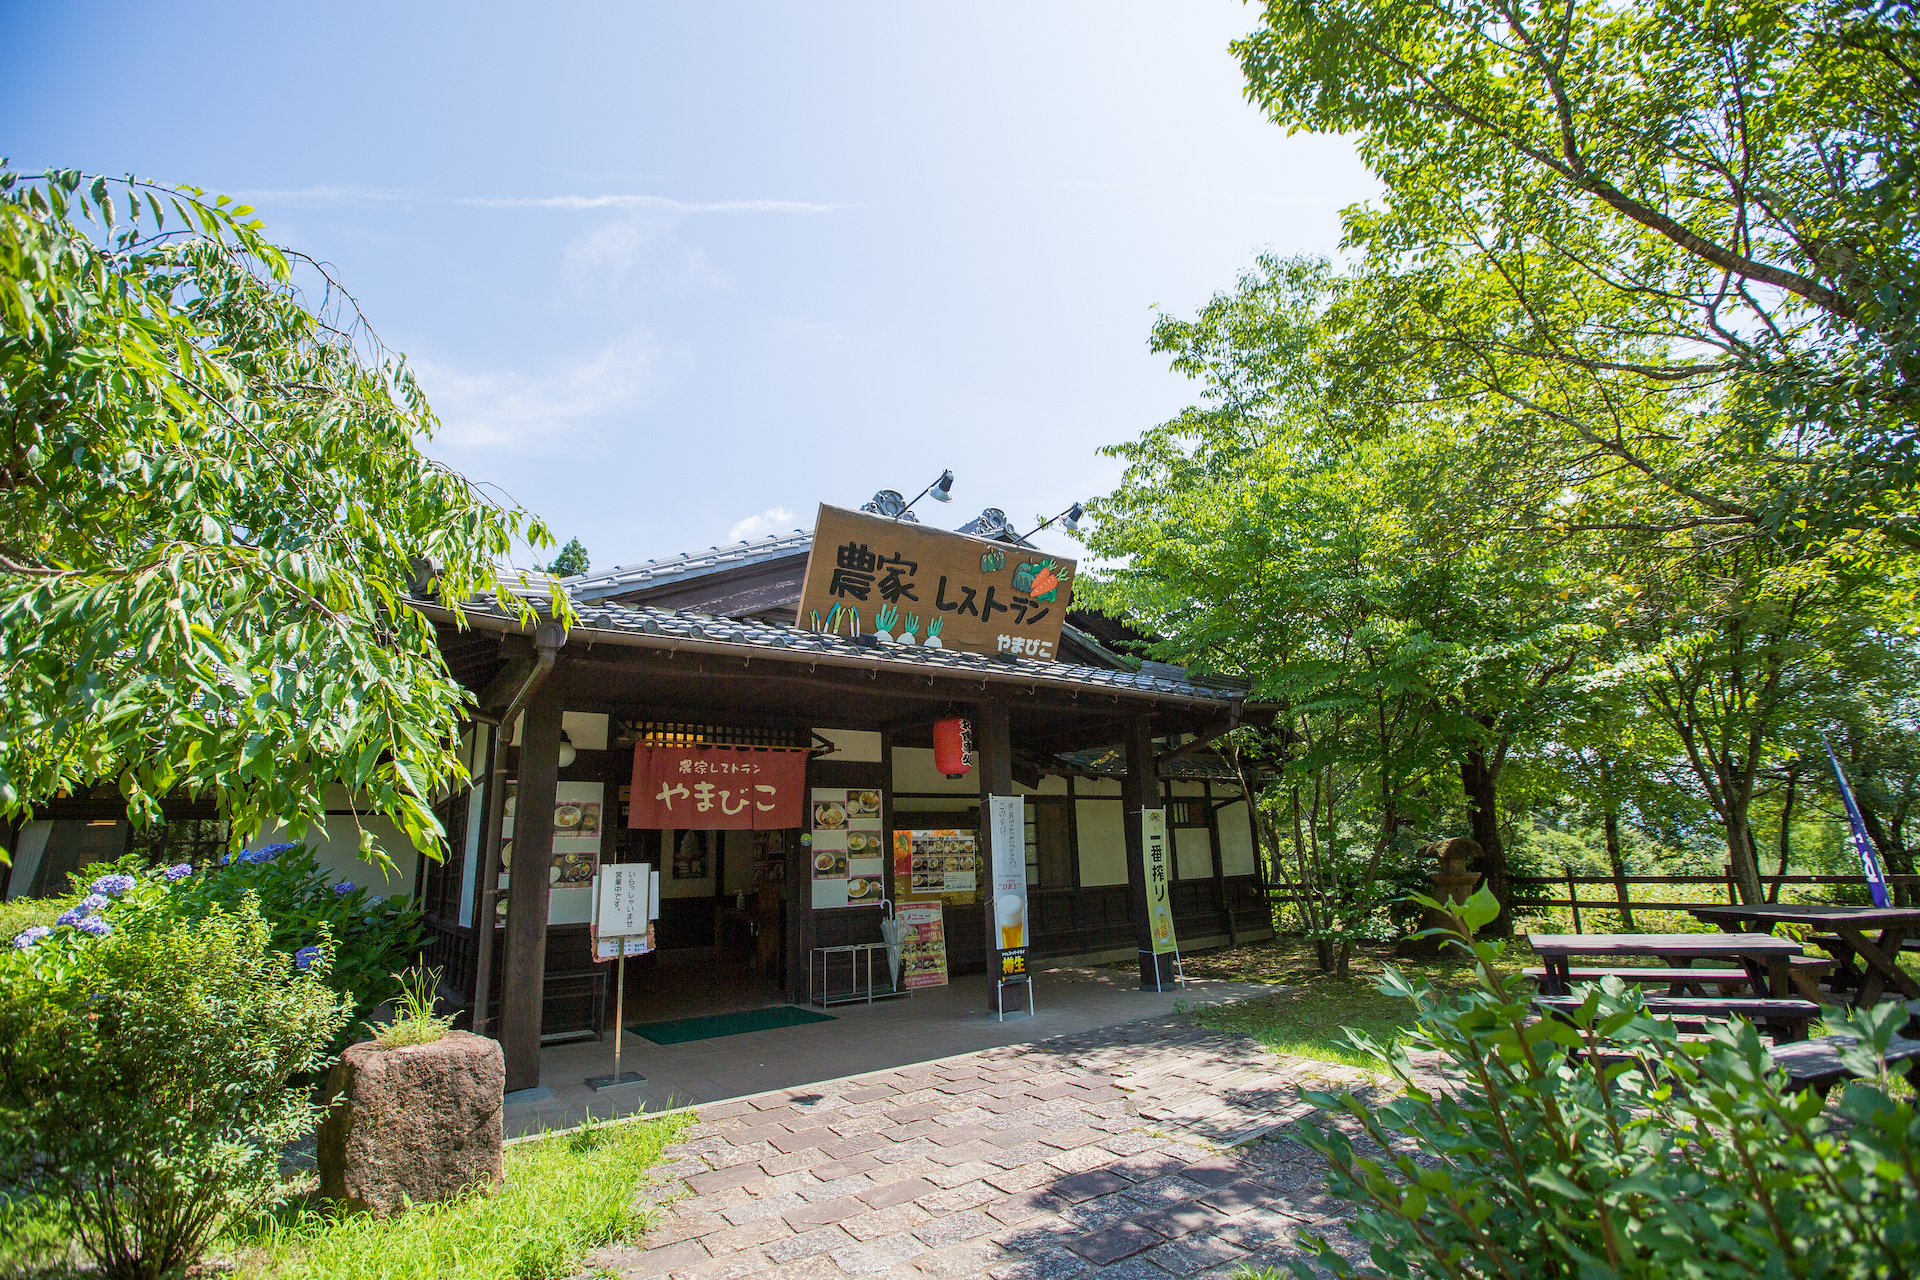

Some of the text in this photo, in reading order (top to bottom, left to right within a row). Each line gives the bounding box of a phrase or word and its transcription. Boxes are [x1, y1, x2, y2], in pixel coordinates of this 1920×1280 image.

[829, 541, 1050, 626] 農家 レストラン
[997, 634, 1053, 659] やまびこ
[679, 758, 761, 775] 農家レストラン
[655, 780, 777, 815] やまびこ
[1150, 835, 1165, 902] 一番搾り
[614, 871, 622, 911] 営業中です。
[627, 871, 636, 928] いらっしゃいませ
[1002, 955, 1026, 975] 樽生
